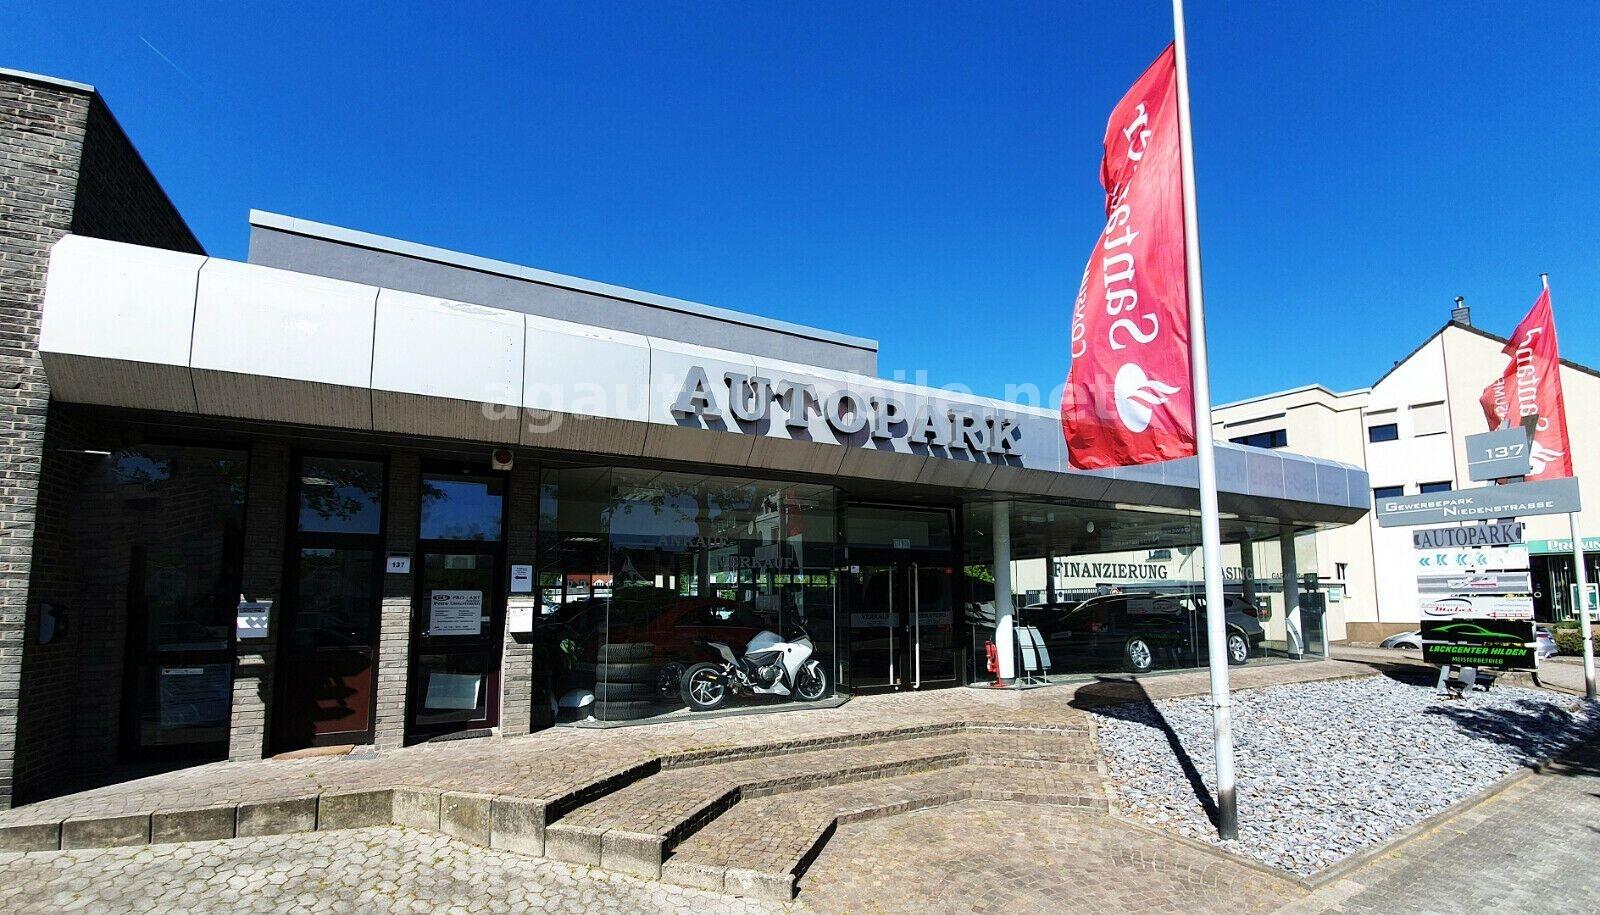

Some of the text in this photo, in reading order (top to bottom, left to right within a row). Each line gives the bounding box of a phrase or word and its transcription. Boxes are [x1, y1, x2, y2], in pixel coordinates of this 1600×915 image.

[670, 366, 1023, 457] AUTOPARK
[1485, 444, 1524, 459] 137
[1385, 497, 1474, 512] GEWERBEPARK
[1443, 500, 1554, 517] NIEDENSTRASSE
[1421, 524, 1514, 548] AUTOPARK
[1053, 562, 1168, 579] FINANZIERUNG
[1203, 566, 1254, 580] ASING
[1429, 645, 1528, 657] LACKCENTER HILDEN
